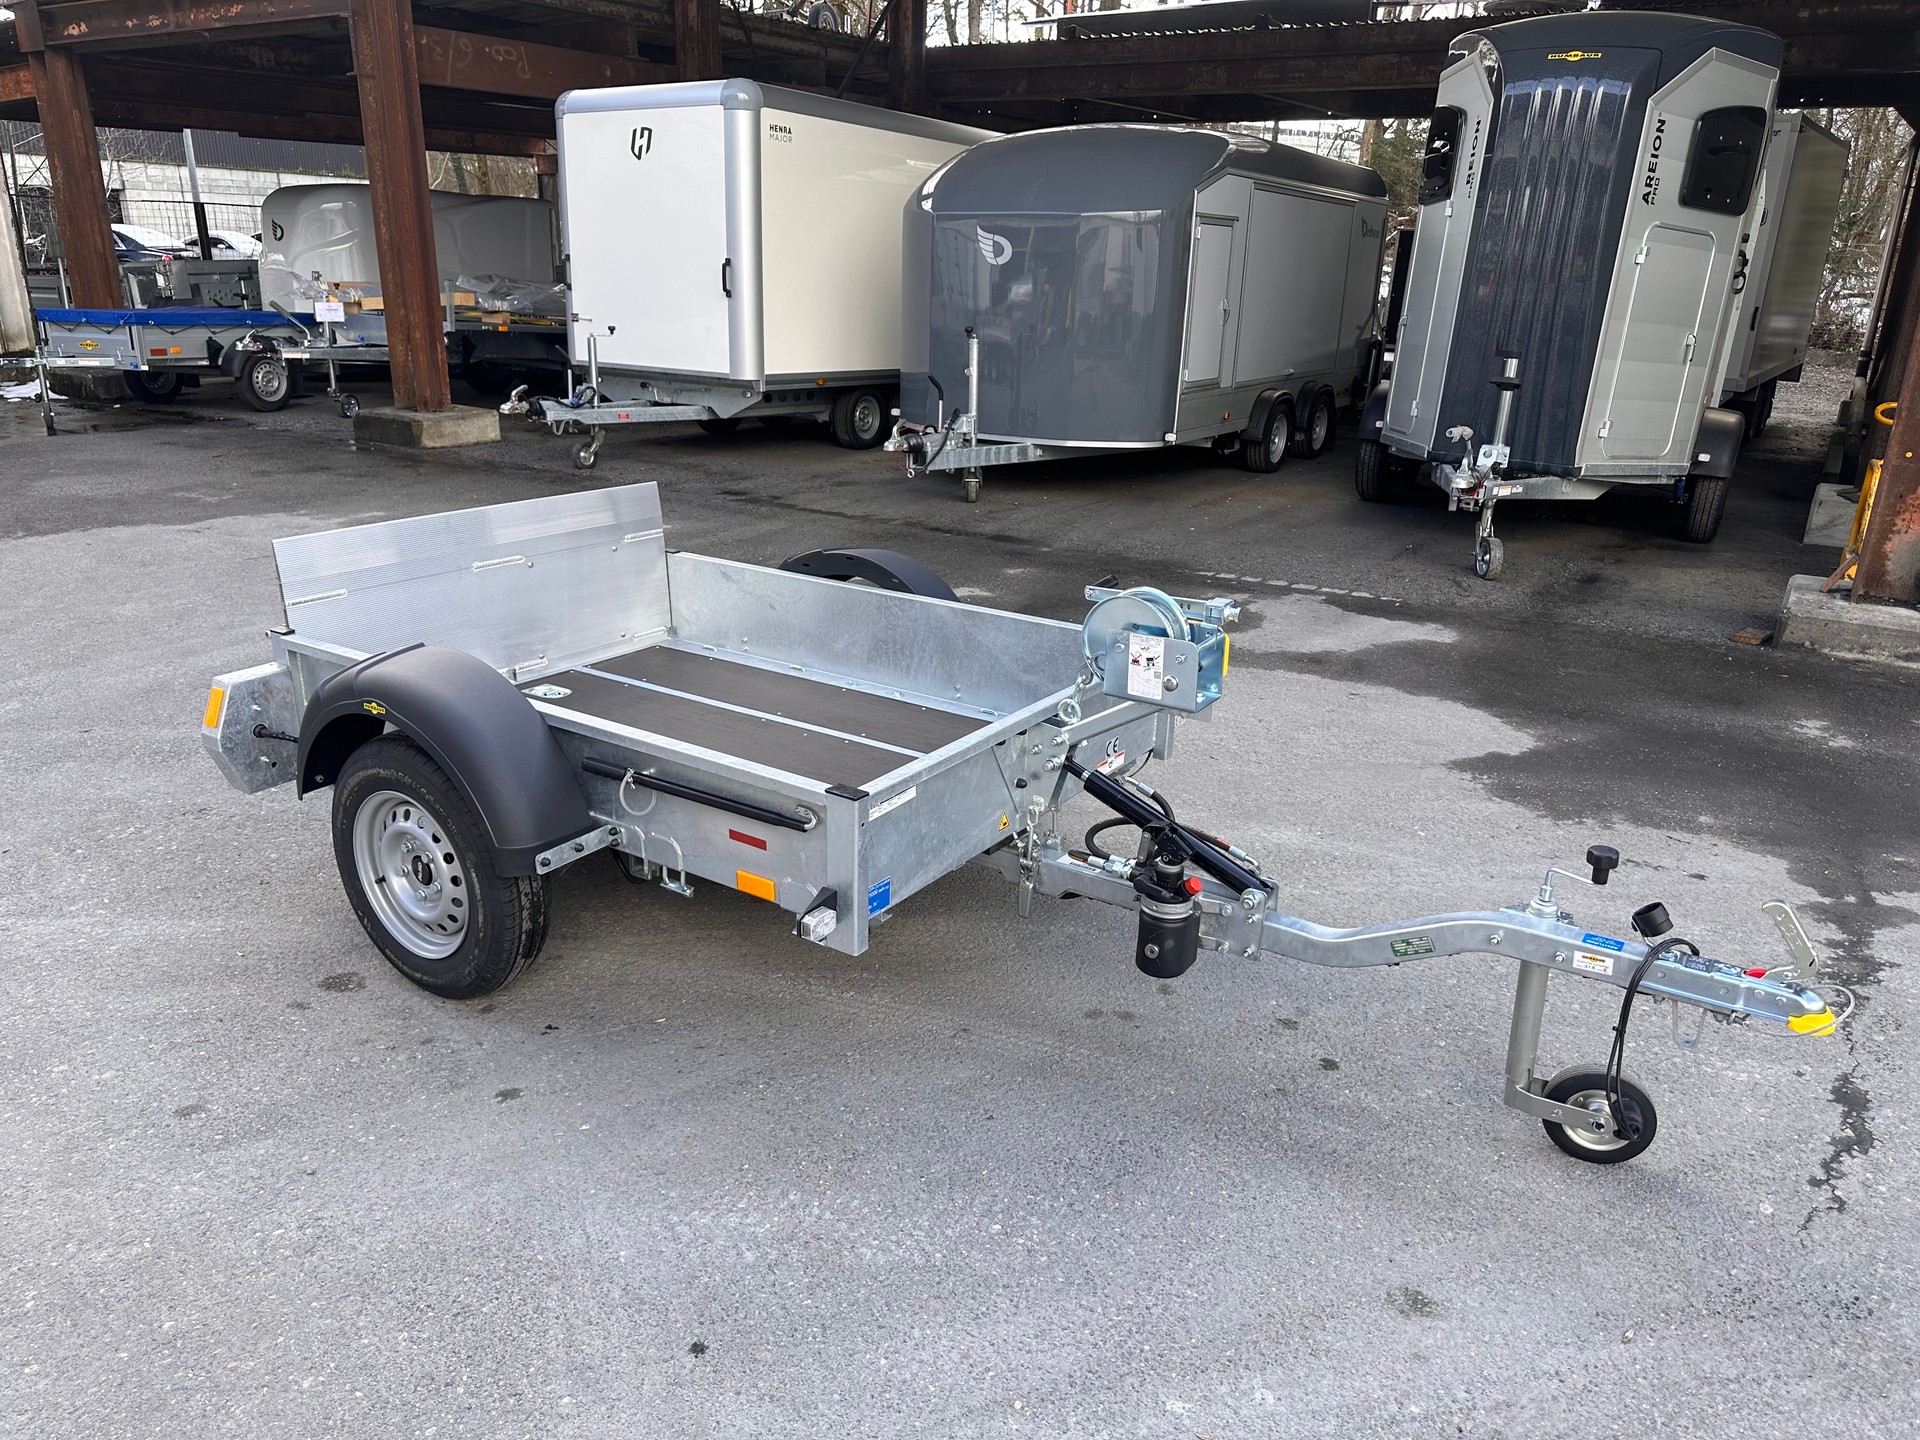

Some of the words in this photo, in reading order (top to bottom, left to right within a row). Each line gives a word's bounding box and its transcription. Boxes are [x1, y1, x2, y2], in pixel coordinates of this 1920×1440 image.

[769, 123, 793, 135] HENRA
[769, 133, 793, 144] MAJOR
[1642, 118, 1666, 206] AREION
[1650, 178, 1660, 206] PRO
